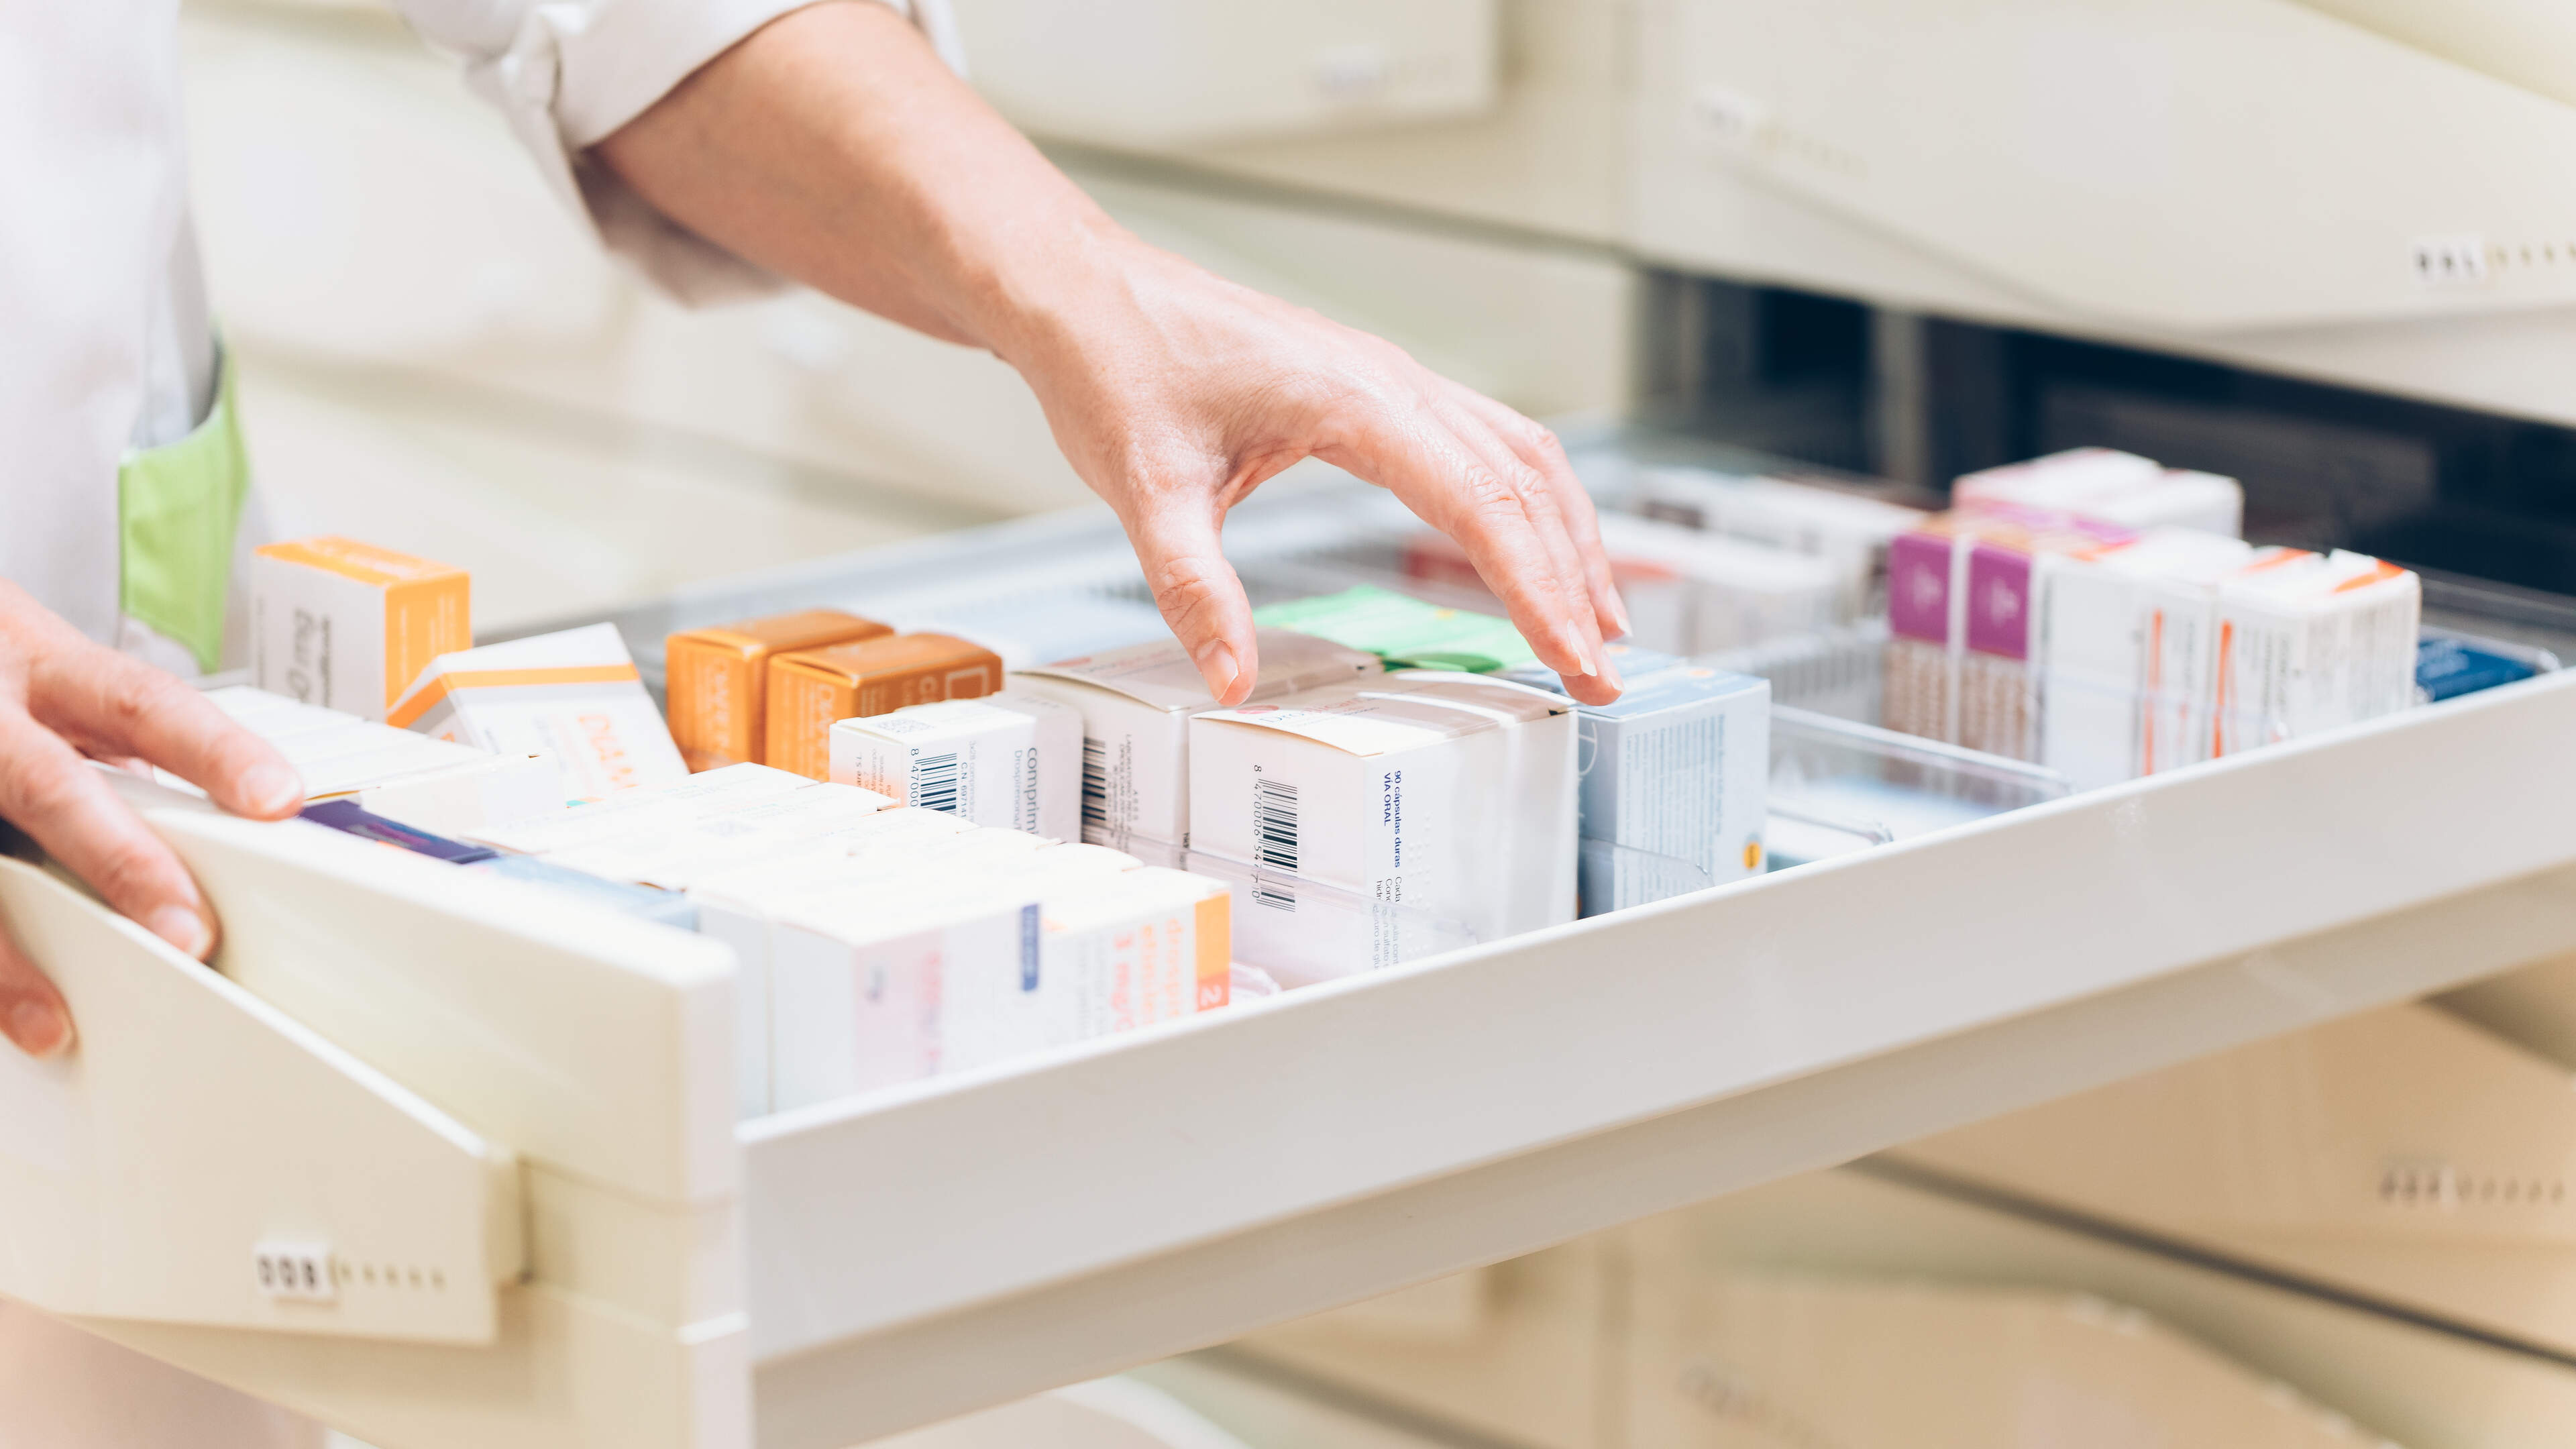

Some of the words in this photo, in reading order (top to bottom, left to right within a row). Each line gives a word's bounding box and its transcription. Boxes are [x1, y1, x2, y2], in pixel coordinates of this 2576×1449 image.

[1253, 764, 1262, 772] 8
[1394, 771, 1401, 784] 90
[910, 766, 920, 807] 47000
[1384, 773, 1392, 792] VÍA
[1253, 784, 1262, 837] 470006
[1393, 787, 1403, 834] cápsulas
[1394, 837, 1402, 867] duras
[1395, 876, 1403, 902] Cada
[1199, 984, 1222, 1006] 2
